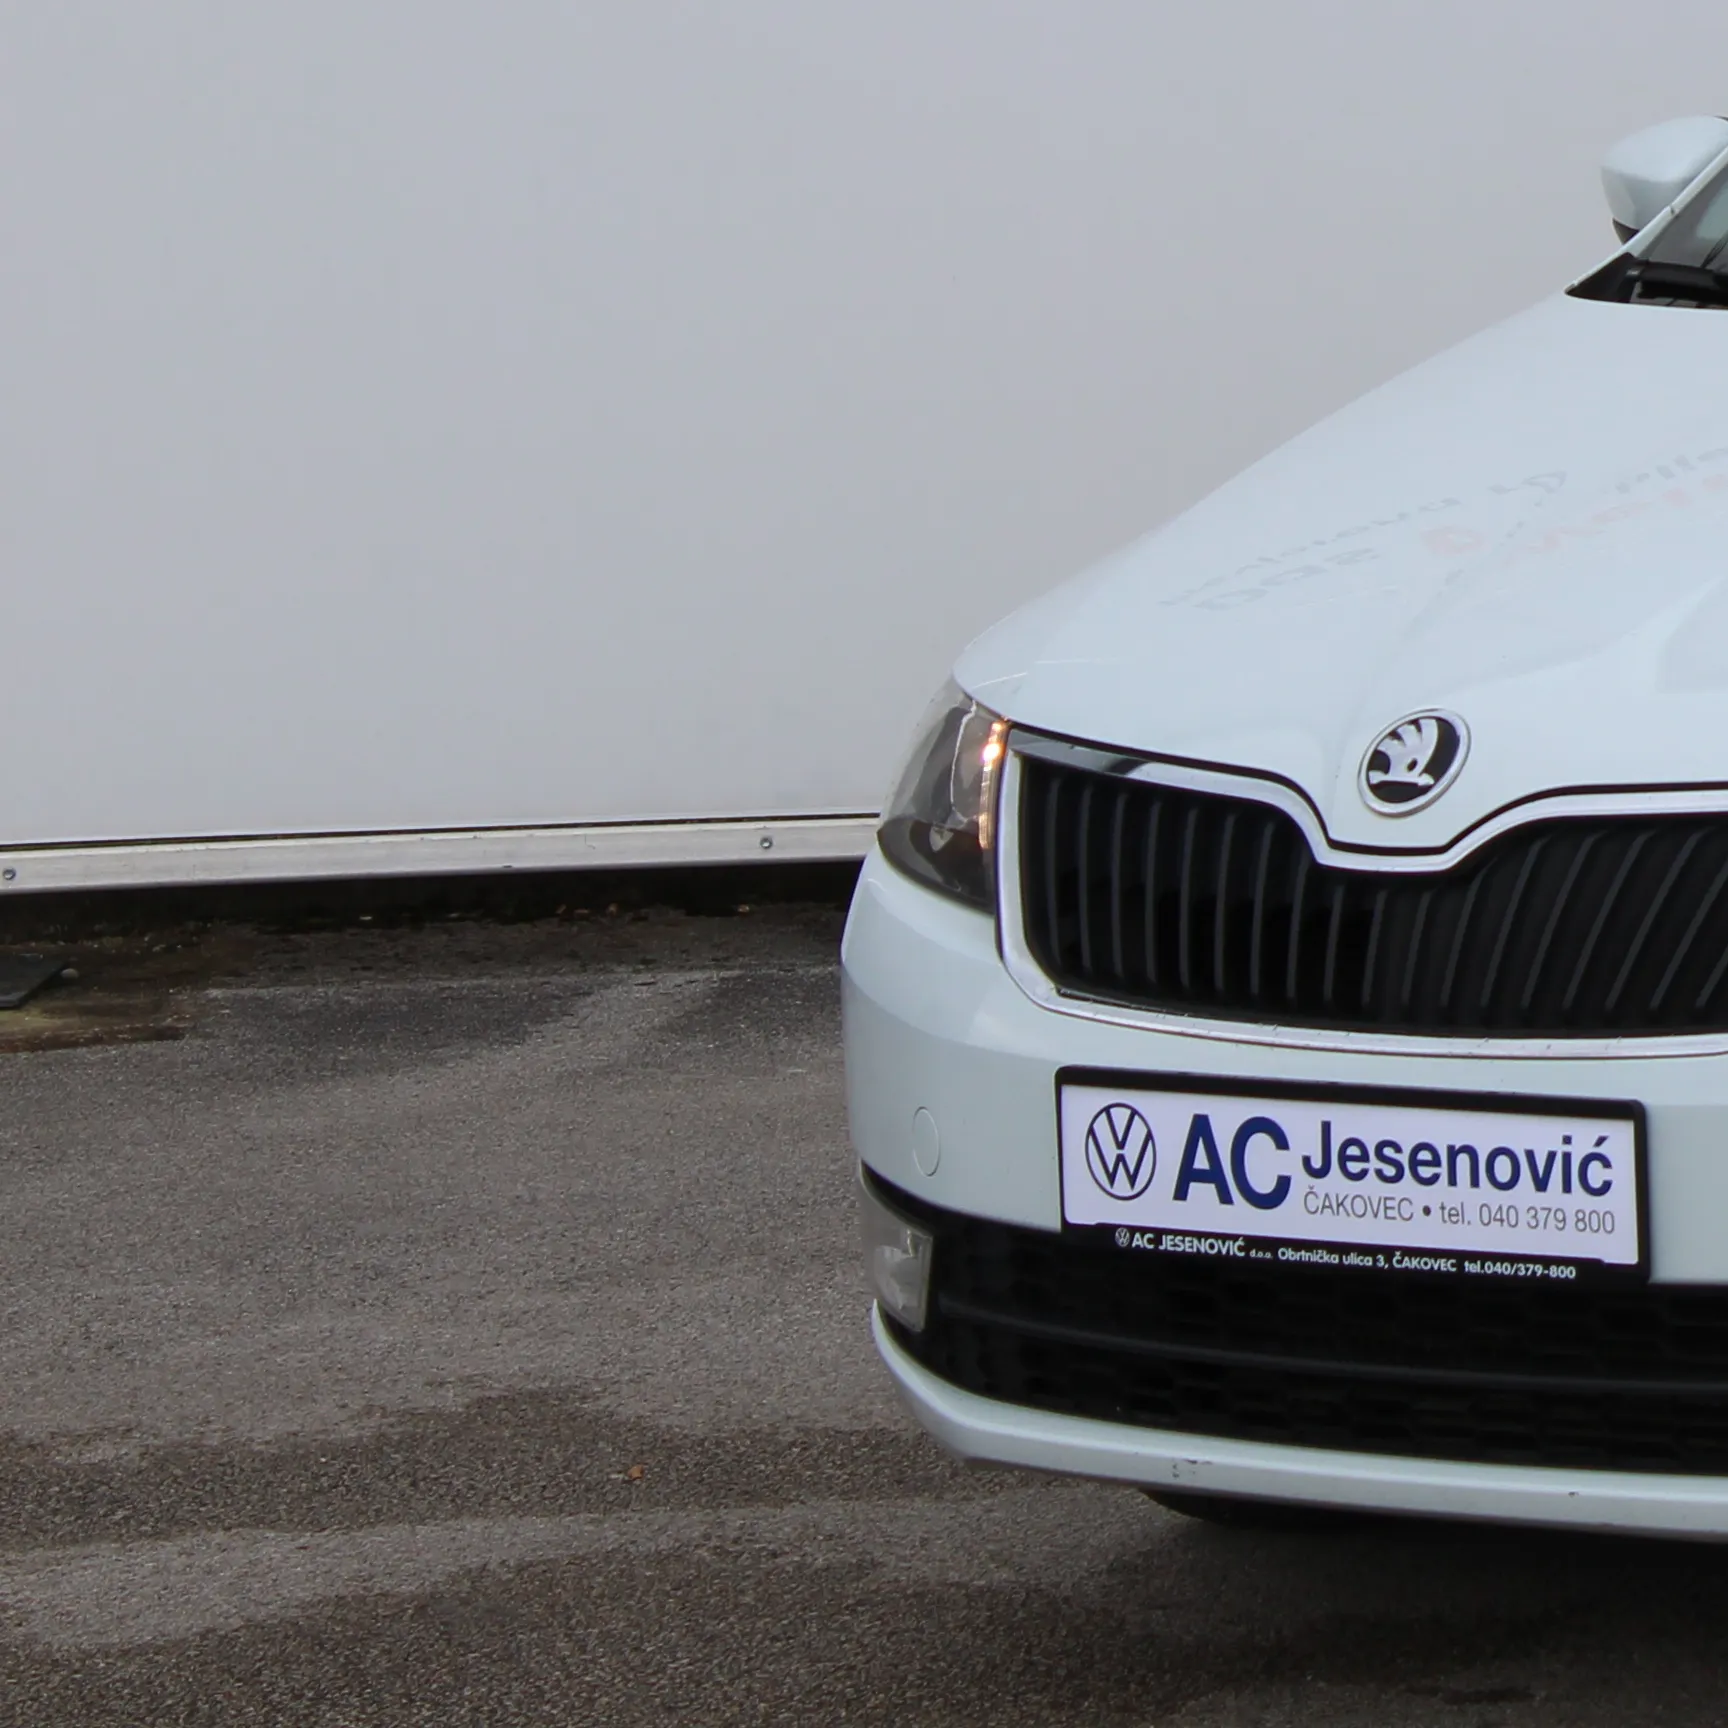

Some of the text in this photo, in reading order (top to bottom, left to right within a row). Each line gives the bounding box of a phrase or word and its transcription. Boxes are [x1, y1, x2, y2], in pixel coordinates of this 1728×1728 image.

[1172, 1113, 1614, 1210] AC Jesenović
[1303, 1185, 1616, 1235] ČAKOVEC tel. 040 379 800
[1132, 1232, 1155, 1249] AC
[1159, 1234, 1246, 1257] JESENOVIĆ
[1278, 1247, 1339, 1264] Obrtnička
[1343, 1253, 1373, 1267] ulica
[1392, 1251, 1457, 1272] ČAKOVEC
